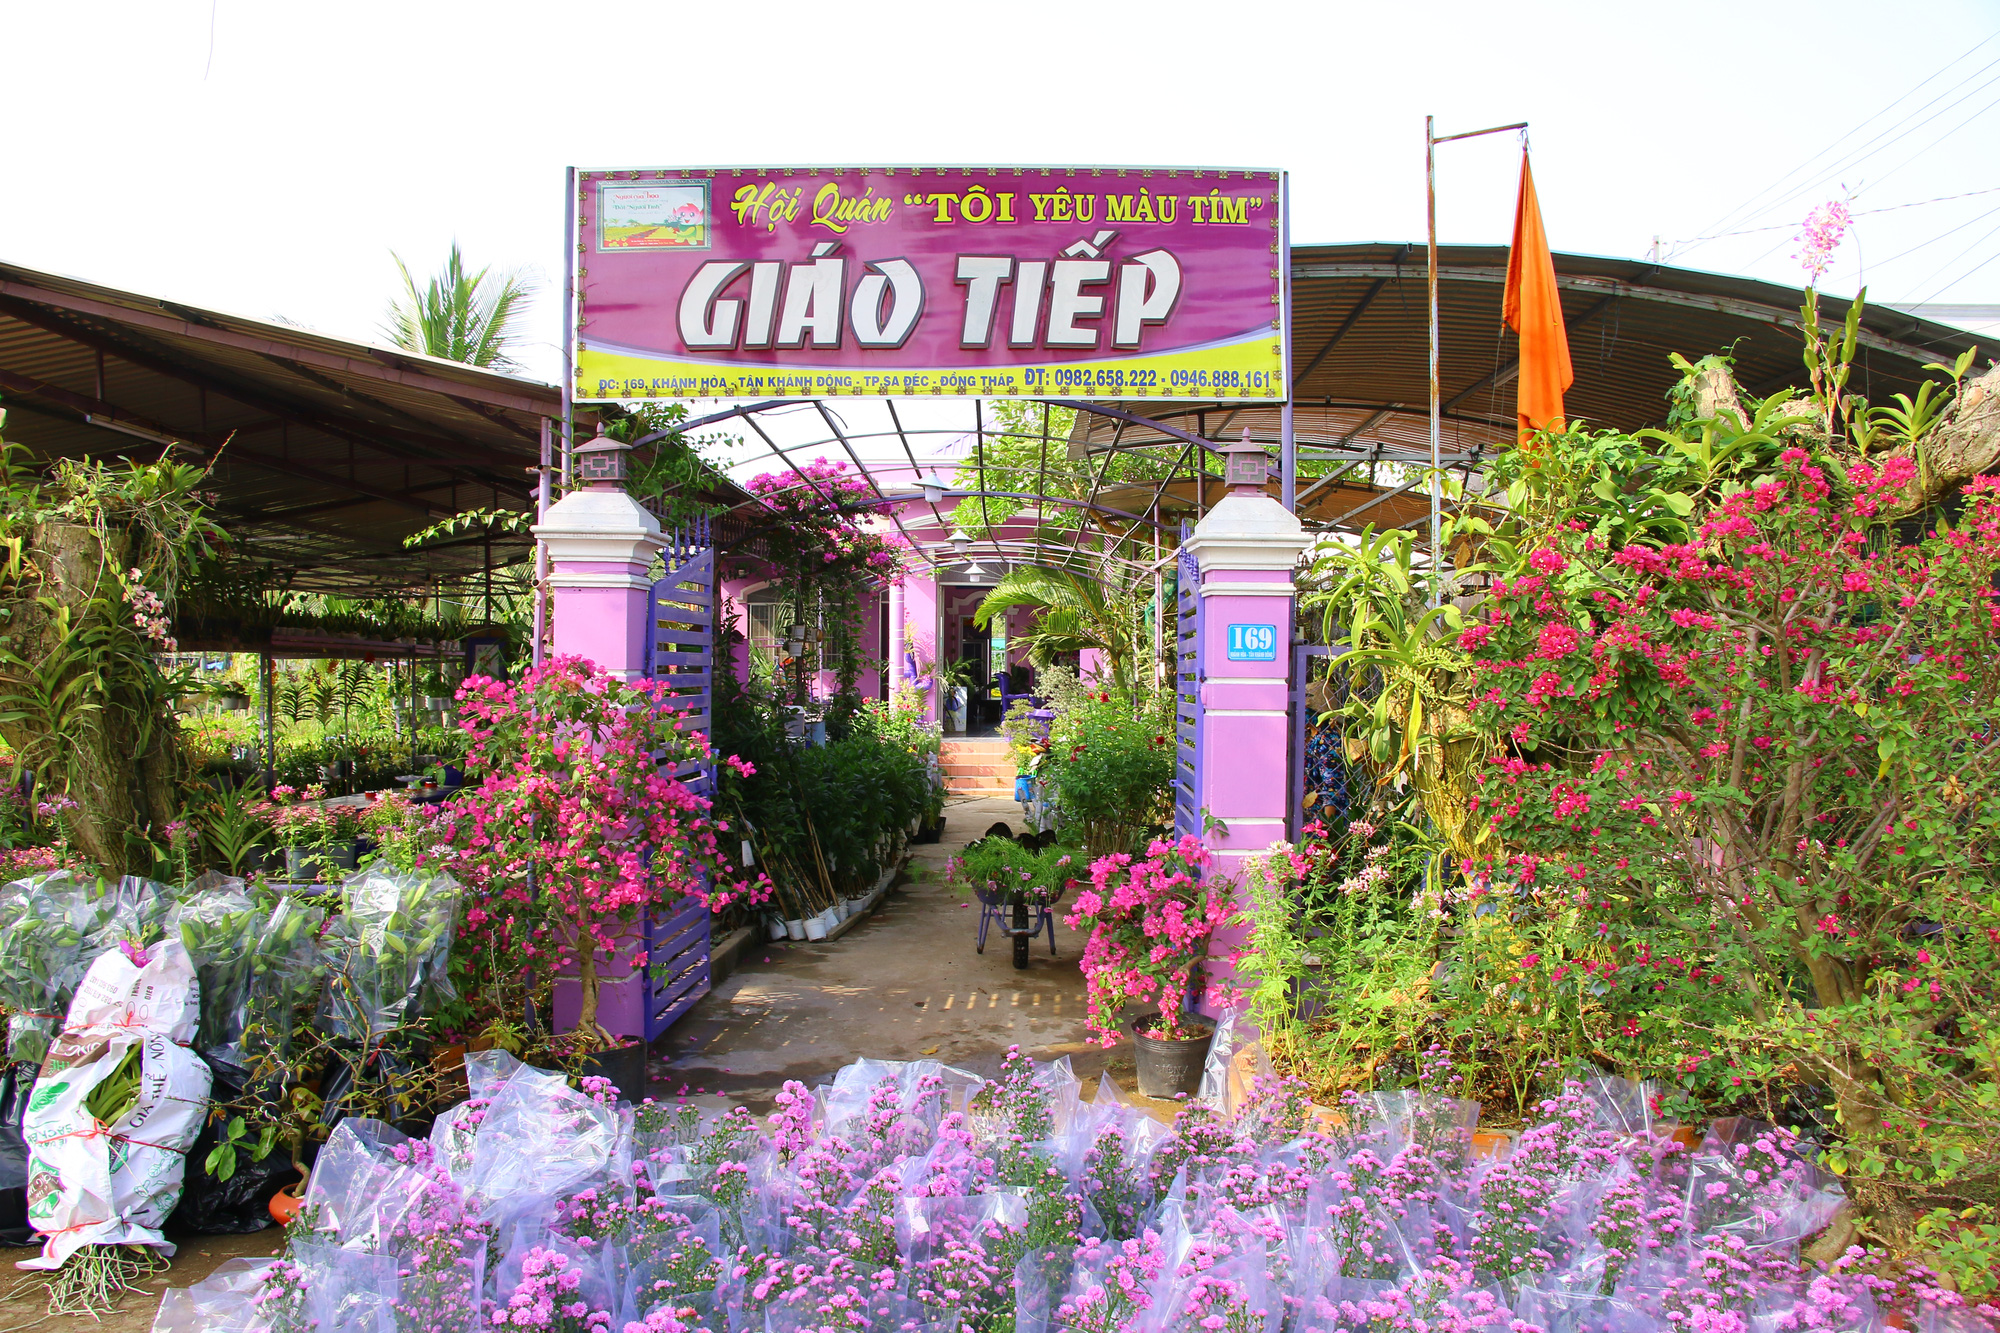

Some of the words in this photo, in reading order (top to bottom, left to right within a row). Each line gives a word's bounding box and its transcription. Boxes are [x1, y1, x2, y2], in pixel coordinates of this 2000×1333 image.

[730, 181, 803, 233] Hội
[811, 182, 893, 233] Quán
[1030, 186, 1096, 222] YÊU
[1105, 187, 1178, 223] MÀU
[675, 239, 926, 352] GIÁO
[953, 227, 1183, 351] TIẾP
[599, 379, 619, 390] ĐC:
[623, 378, 648, 391] 169,
[652, 375, 697, 389] KHÁNH
[701, 374, 728, 388] HÒA
[738, 375, 763, 388] TÂN
[768, 373, 814, 388] KHÁNH
[816, 373, 852, 387] ĐÔNG
[864, 375, 899, 387] TP.SA
[903, 372, 929, 387] ĐÉC
[940, 371, 976, 387] ĐỒNG
[980, 372, 1015, 387] THÁP
[1025, 368, 1050, 386] ĐT:
[1054, 368, 1157, 387] 0982.658.222
[1170, 369, 1271, 389] 0946.888.161
[1233, 627, 1272, 650] 169
